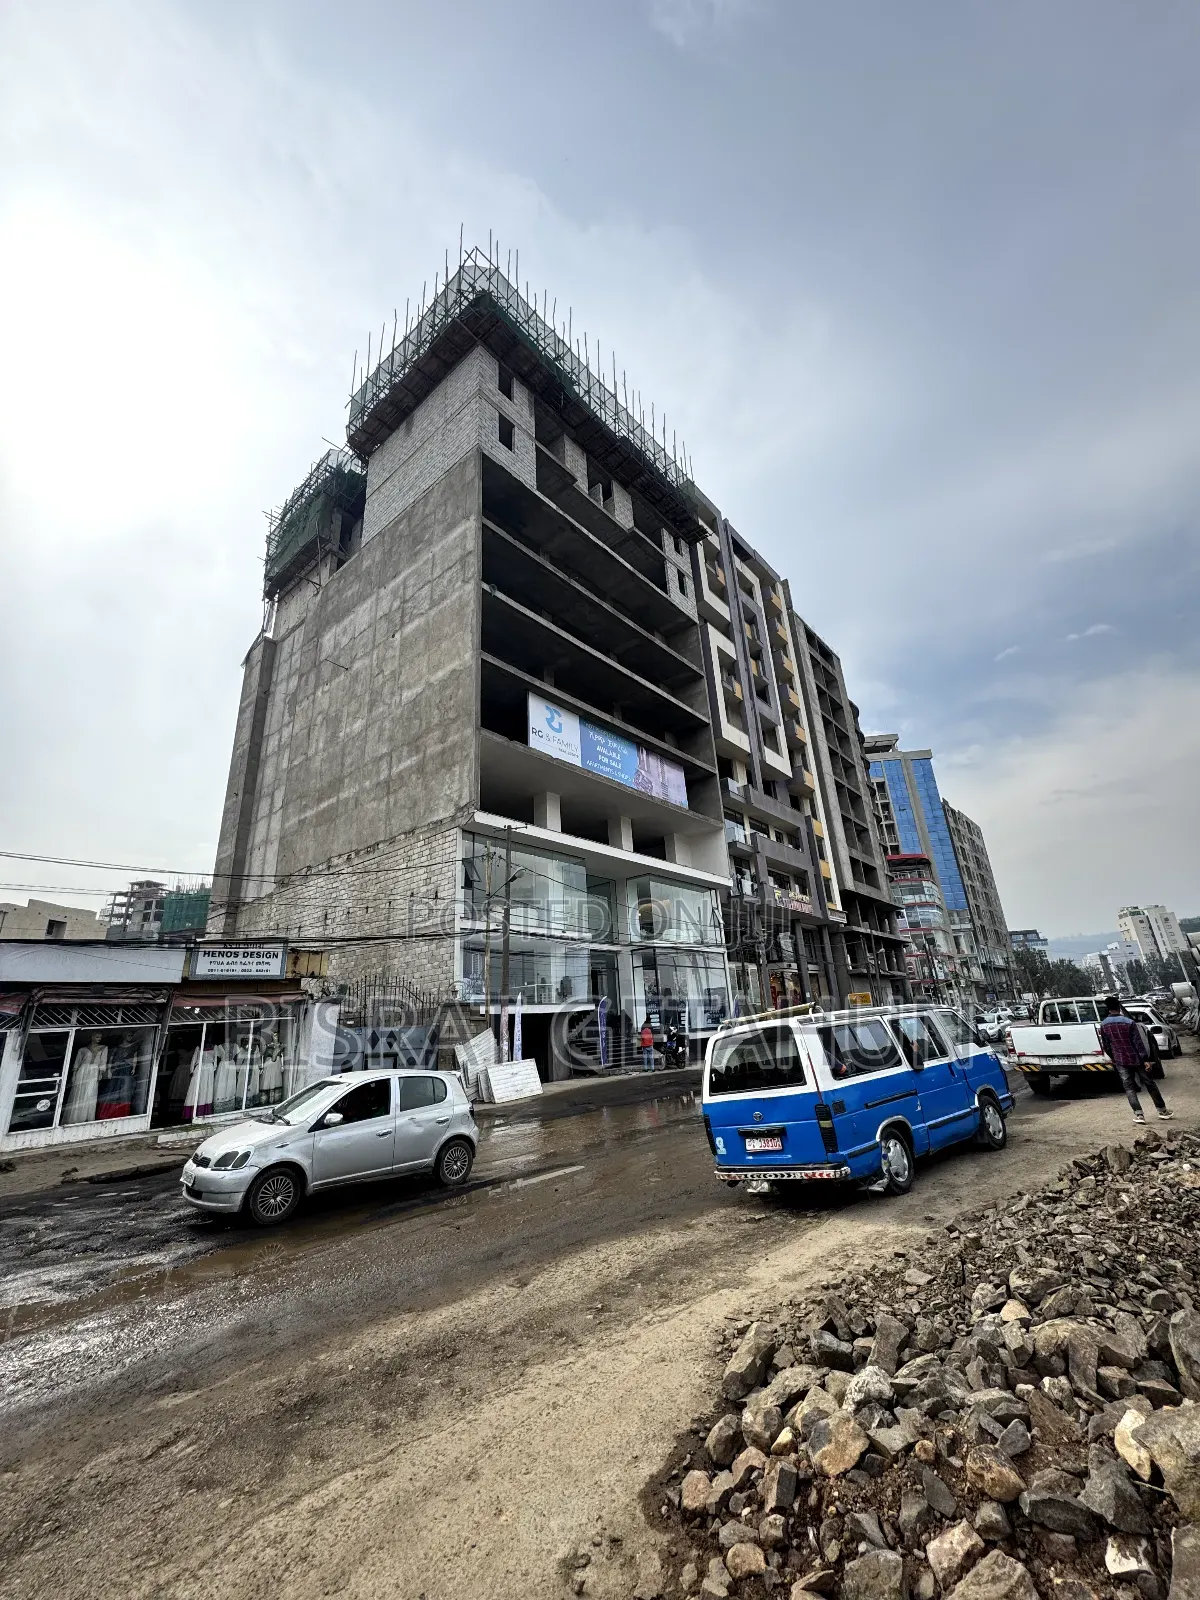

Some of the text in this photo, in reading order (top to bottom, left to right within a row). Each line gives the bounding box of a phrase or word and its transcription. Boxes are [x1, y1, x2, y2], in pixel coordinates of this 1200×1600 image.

[531, 726, 544, 739] RG
[552, 735, 579, 753] FAMILY
[598, 754, 622, 770] FOR SALE
[202, 949, 280, 960] HENOS DESIGN
